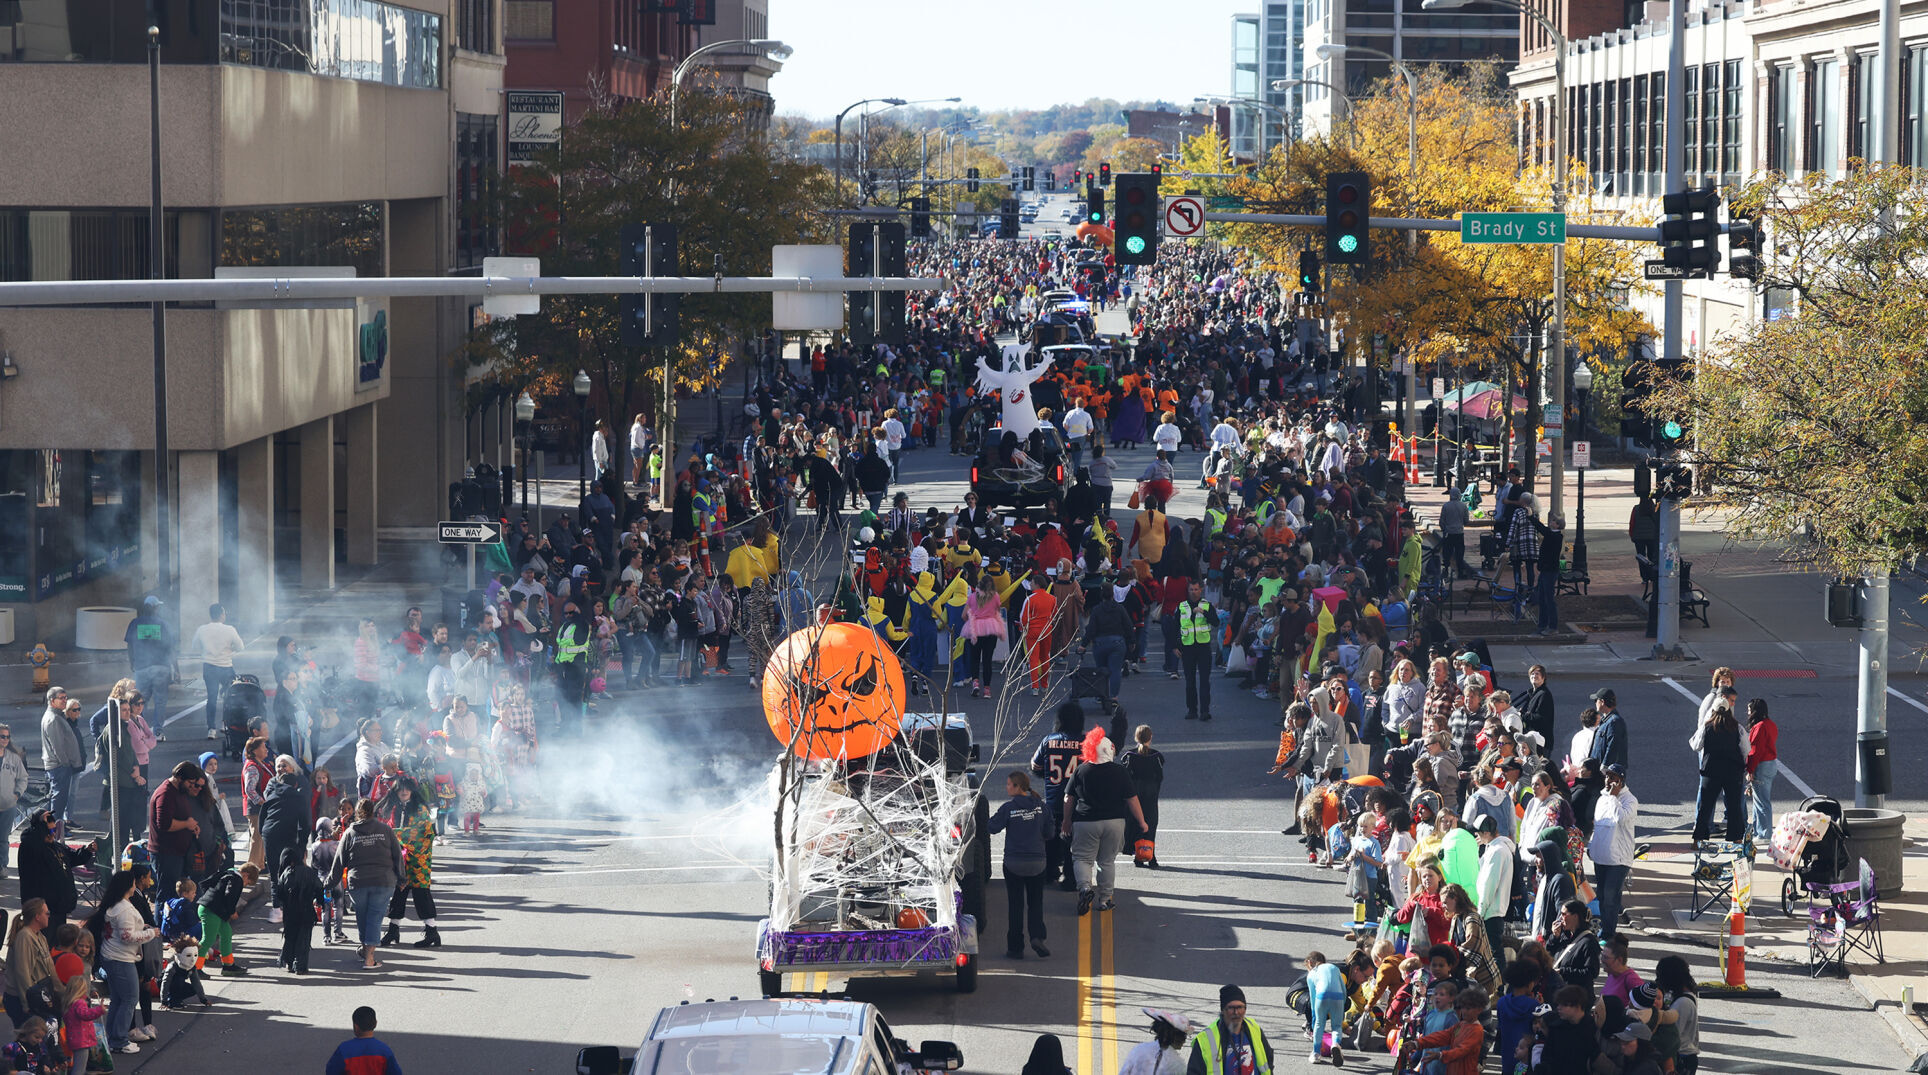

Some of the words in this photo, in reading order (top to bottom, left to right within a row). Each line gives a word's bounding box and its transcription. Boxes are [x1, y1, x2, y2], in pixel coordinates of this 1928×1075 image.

[1471, 220, 1524, 239] Brady
[1537, 220, 1556, 236] St
[1650, 265, 1667, 274] ONE
[444, 528, 461, 537] ONE
[465, 528, 481, 537] WAY
[1048, 740, 1079, 749] URLACHER
[1049, 754, 1079, 784] 54
